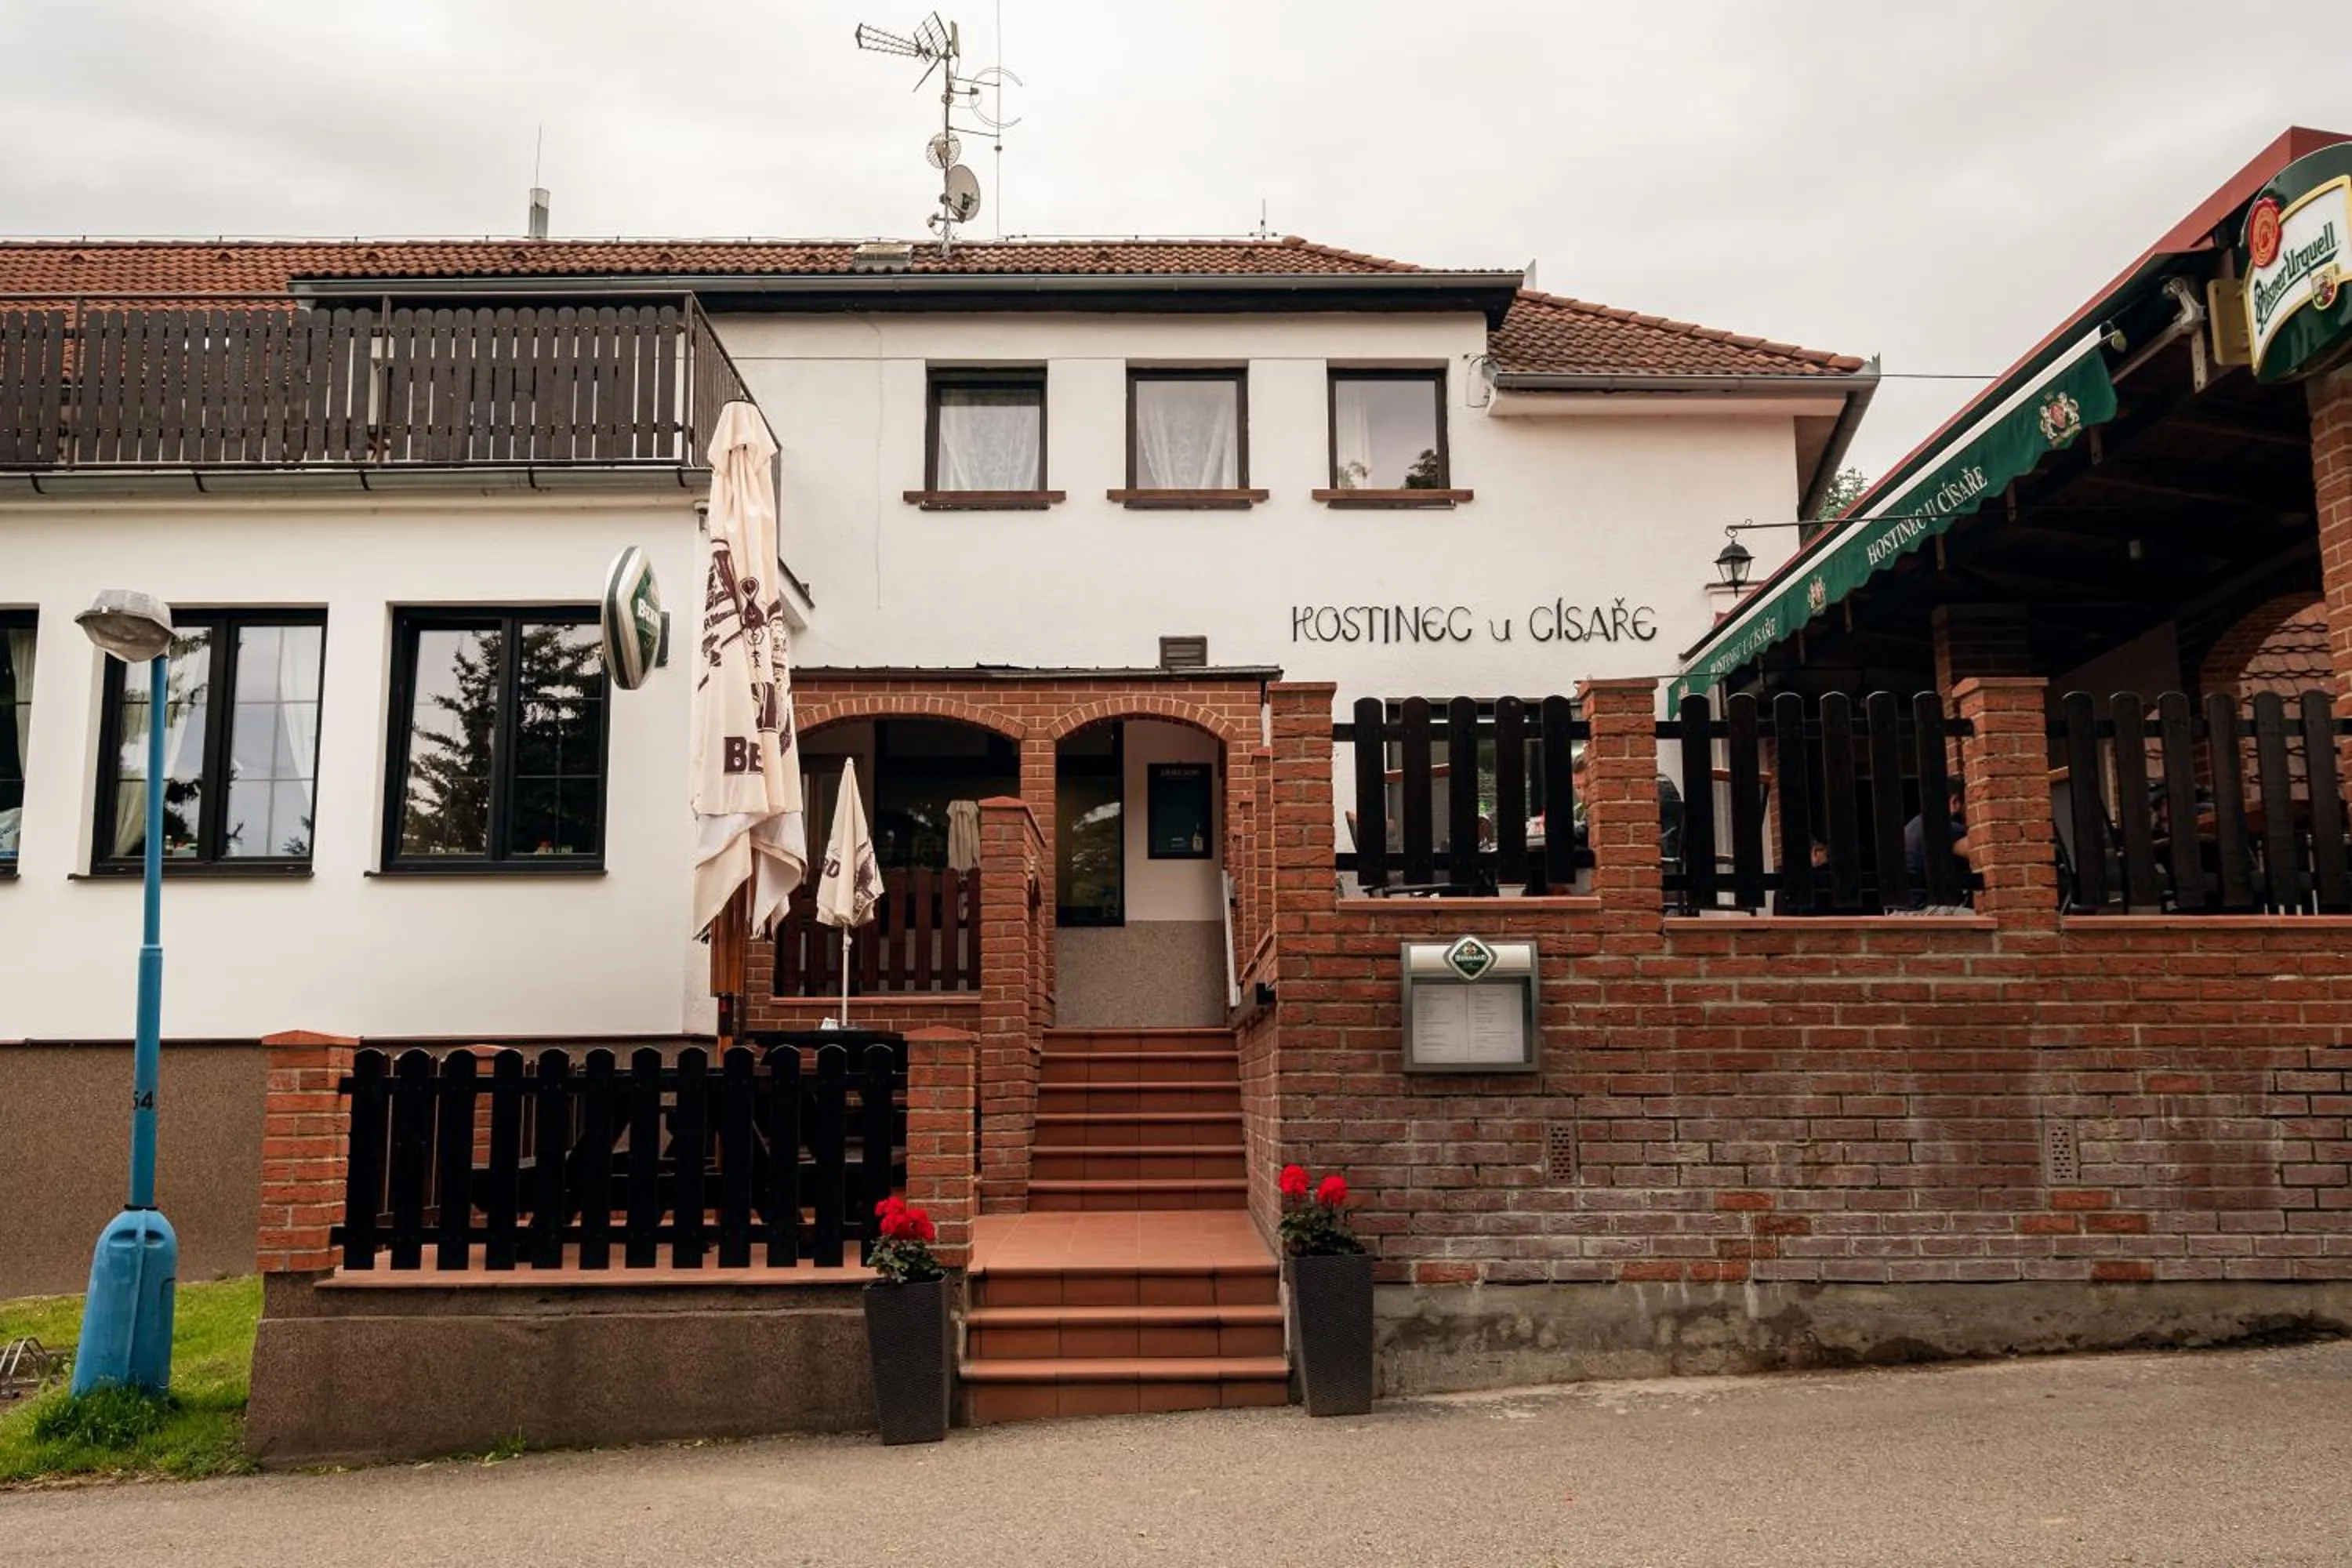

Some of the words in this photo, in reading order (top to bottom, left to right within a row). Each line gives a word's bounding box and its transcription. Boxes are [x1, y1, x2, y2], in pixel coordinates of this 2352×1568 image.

[2283, 220, 2336, 278] Urquell
[1865, 507, 1927, 565] HOSTINEC
[1936, 466, 1988, 513] CÍSAŘE
[1291, 605, 1473, 644] HOSTINEC
[1529, 597, 1658, 642] CÍSAŘE
